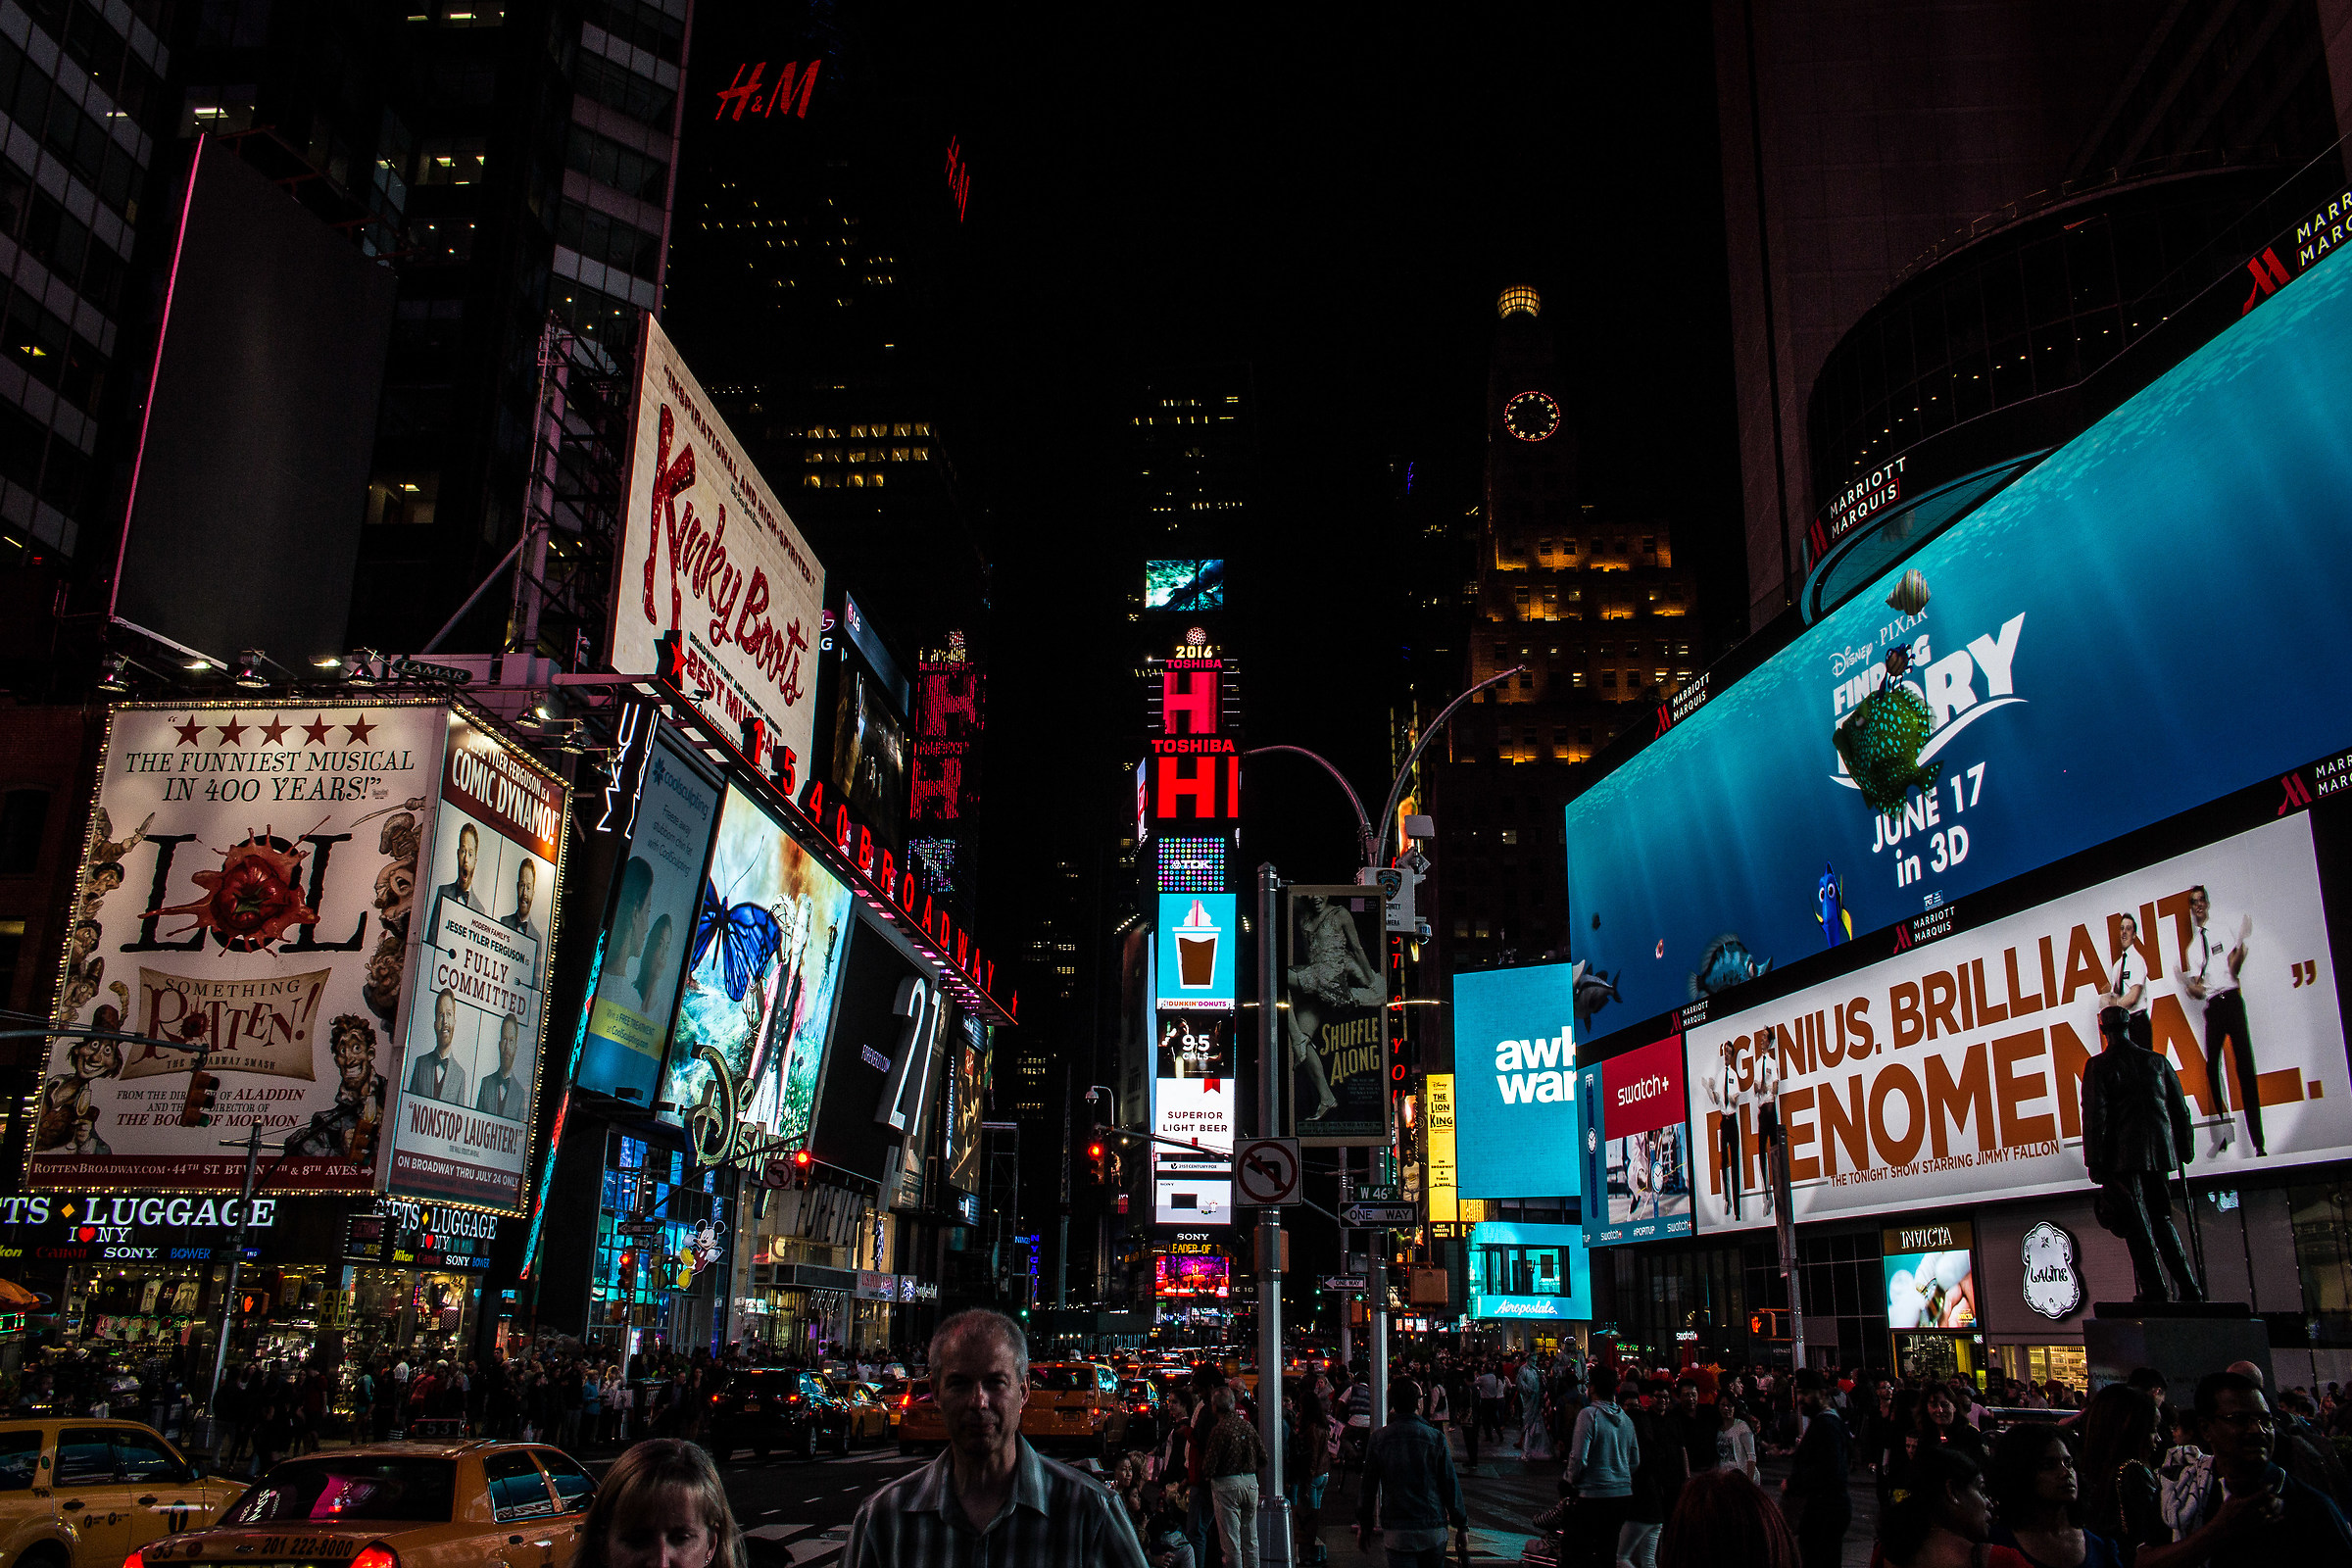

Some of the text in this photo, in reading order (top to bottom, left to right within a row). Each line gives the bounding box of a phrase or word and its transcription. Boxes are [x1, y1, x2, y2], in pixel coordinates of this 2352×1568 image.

[716, 59, 821, 121] H&M
[739, 481, 758, 506] AND
[1830, 456, 1906, 519] MARRIOTT
[1833, 483, 1897, 539] MARQUIS
[643, 403, 742, 647] Kinky
[734, 565, 808, 707] Boots
[1176, 646, 1213, 659] 2016
[401, 662, 466, 680] LAMAR
[1166, 660, 1223, 669] TOSHIBA
[687, 646, 725, 708] BEST
[1673, 672, 1710, 707] MARRIOTT
[1673, 690, 1707, 721] MARQUIS
[1152, 739, 1236, 754] TOSHIBA
[126, 750, 416, 773] THE FUNNIEST MUSICAL
[452, 747, 494, 808] COMIC
[509, 755, 541, 793] FERGUSON
[162, 777, 198, 802] IN
[204, 778, 261, 803] 400
[663, 770, 709, 821] coolsculpting
[1157, 757, 1239, 818] HI
[1872, 761, 1985, 854] JUNE 17
[1182, 859, 1211, 870] TDK
[1896, 825, 1969, 888] in 3D
[858, 825, 996, 994] BROADWAY
[1913, 906, 1955, 930] MARRIOTT
[471, 918, 490, 936] MODERN
[1914, 921, 1952, 943] MARQUIS
[445, 918, 526, 965] JESSE TYLER FERGUSON
[464, 948, 509, 984] FULLY
[165, 977, 301, 998] SOMETHING
[438, 964, 526, 1017] COMMITTED
[1683, 1000, 1709, 1017] MARRIOTT
[1683, 1011, 1706, 1027] MARQUIS
[1182, 1034, 1210, 1052] 95
[1320, 1016, 1380, 1056] SHUFFLE
[167, 1058, 276, 1071] THE SMASH
[889, 977, 942, 1137] 21
[1183, 1052, 1209, 1060] CALS
[1330, 1045, 1380, 1087] ALONG
[117, 1088, 306, 1102] FROM THE OF ALADDIN
[147, 1103, 270, 1112] AND OF
[1431, 1102, 1449, 1113] LION
[117, 1113, 300, 1128] THE MORMON
[1430, 1114, 1453, 1128] KING
[302, 1163, 321, 1176] 8TH
[398, 1155, 409, 1167] ON
[412, 1157, 455, 1176] BROADWAY
[457, 1166, 474, 1179] THRU
[475, 1170, 492, 1183] JULY
[493, 1174, 501, 1185] 24
[503, 1177, 519, 1188] ONLY
[1831, 1140, 2060, 1188] THE TONIGHT SHOW STARRING JIMMY FALLON
[1360, 1187, 1369, 1200] W
[82, 1198, 276, 1227] LUGGAGE
[430, 1206, 498, 1241] LUGGAGE
[1349, 1209, 1409, 1220] ONE WAY
[68, 1227, 132, 1243] I NY
[434, 1234, 451, 1250] NY
[1900, 1227, 1953, 1250] INVICTA
[35, 1246, 88, 1259] Canon
[170, 1248, 212, 1260] BOWER
[393, 1249, 490, 1268] Nikon Canon SONY BOWER
[263, 1537, 353, 1556] 201 222-8000
